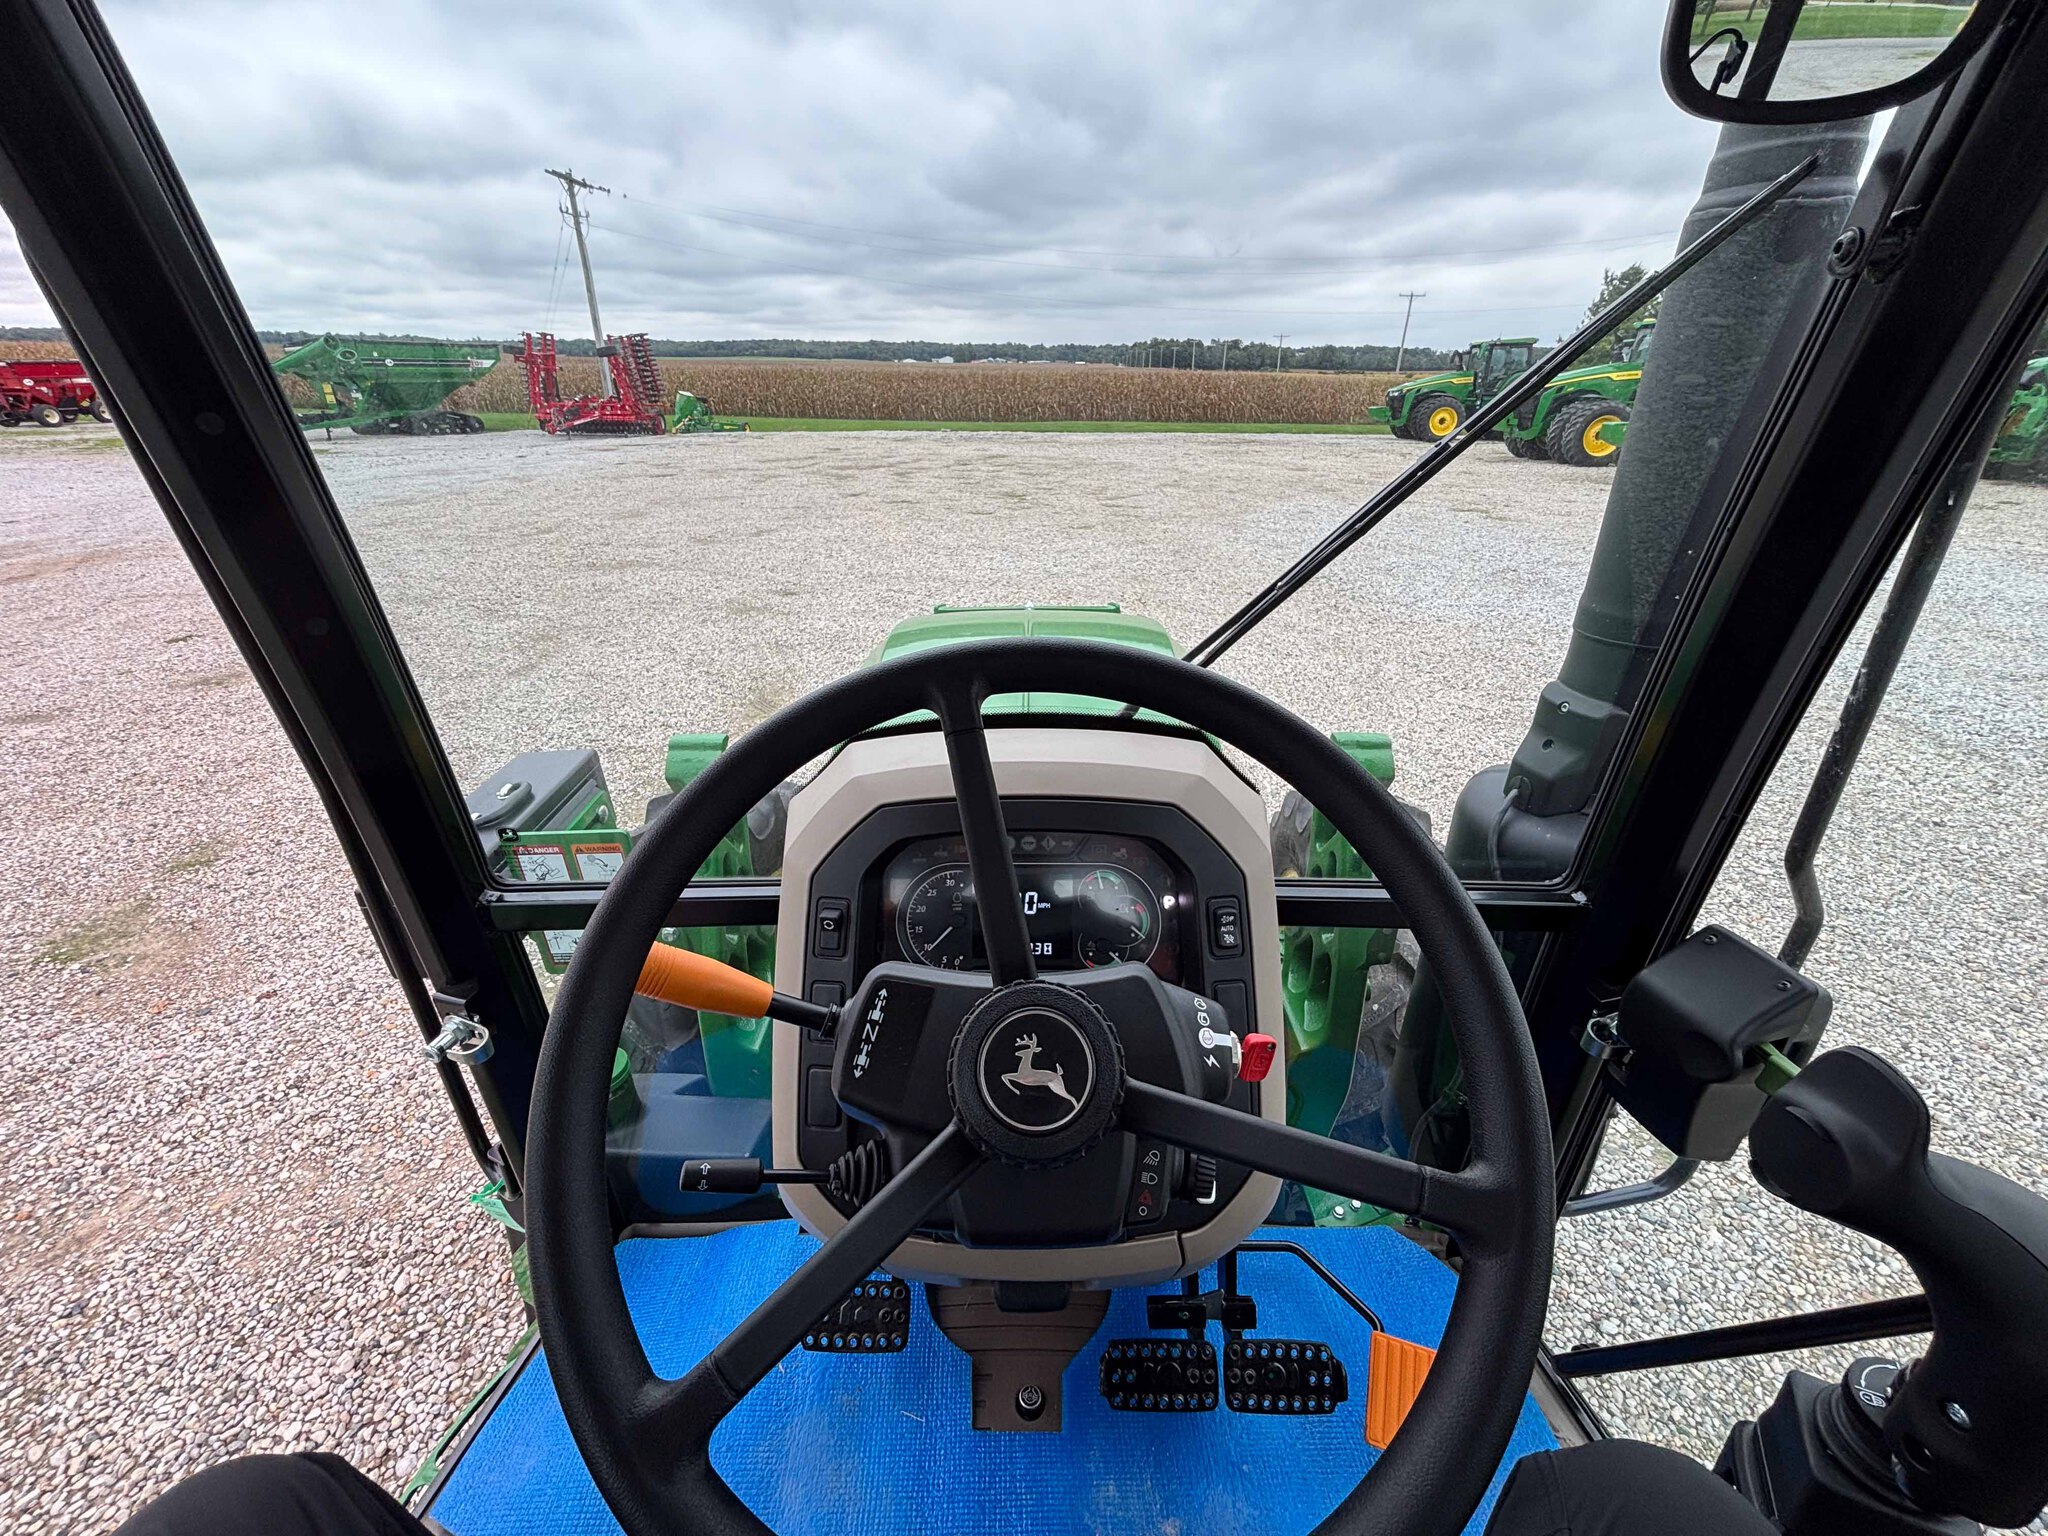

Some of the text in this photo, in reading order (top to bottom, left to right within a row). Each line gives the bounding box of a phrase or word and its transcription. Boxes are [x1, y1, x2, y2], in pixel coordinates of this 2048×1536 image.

[927, 889, 937, 897] 25
[924, 943, 932, 951] 10
[942, 955, 948, 963] 5
[954, 958, 960, 966] 0
[862, 1022, 880, 1042] N
